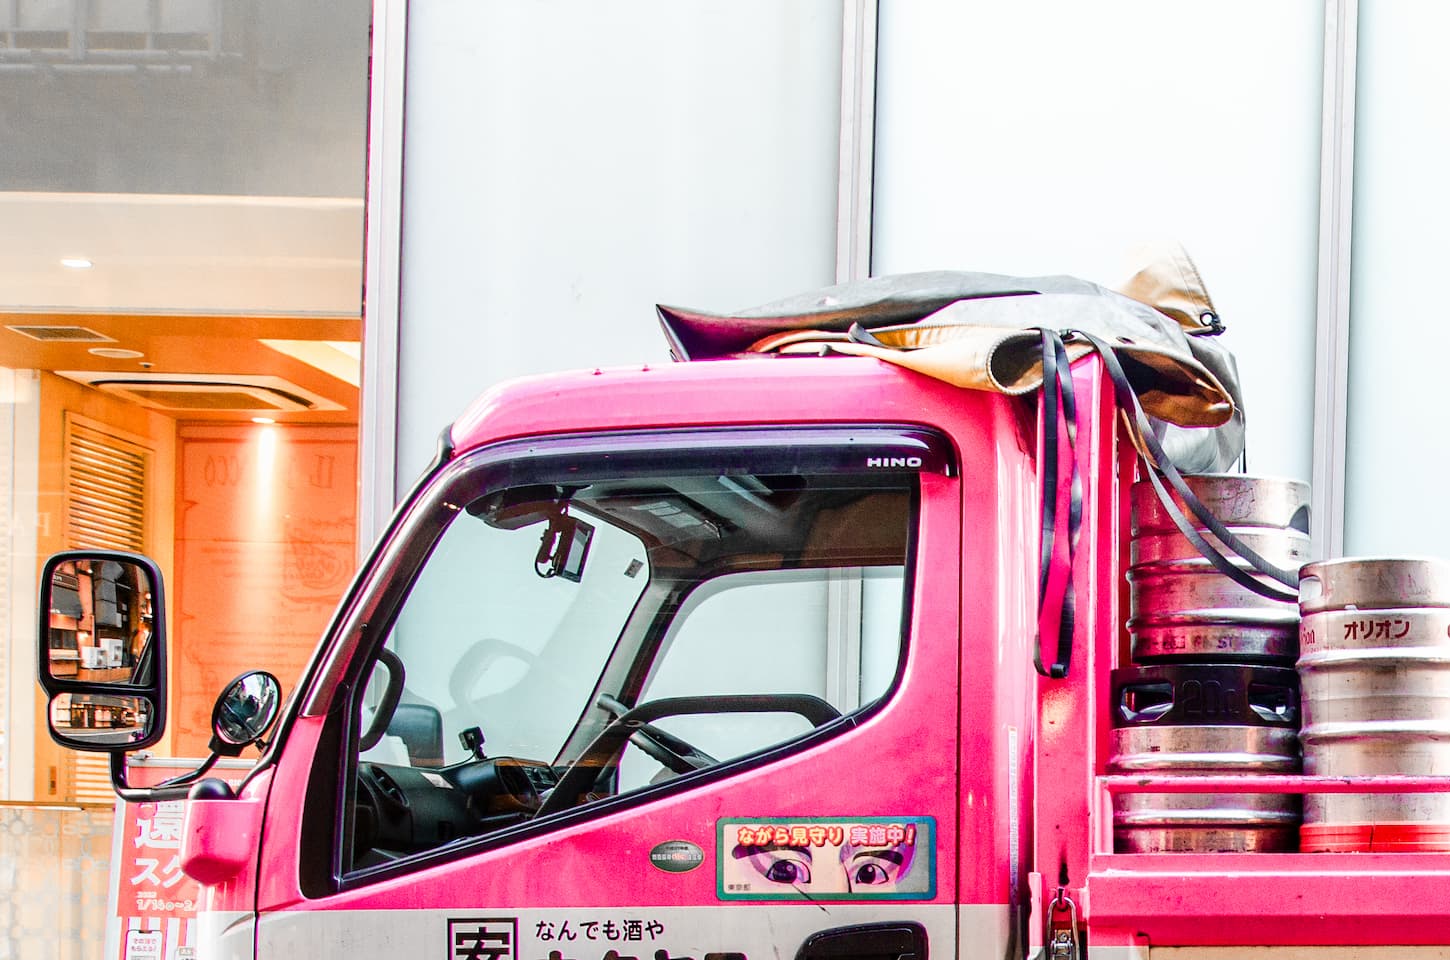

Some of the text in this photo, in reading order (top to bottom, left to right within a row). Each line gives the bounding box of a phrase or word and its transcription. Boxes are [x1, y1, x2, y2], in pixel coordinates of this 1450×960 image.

[867, 457, 922, 468] HINO
[1343, 620, 1410, 640] オリオン
[737, 823, 915, 847] ながら見守り 実施中!
[535, 919, 665, 941] なんでも酒や
